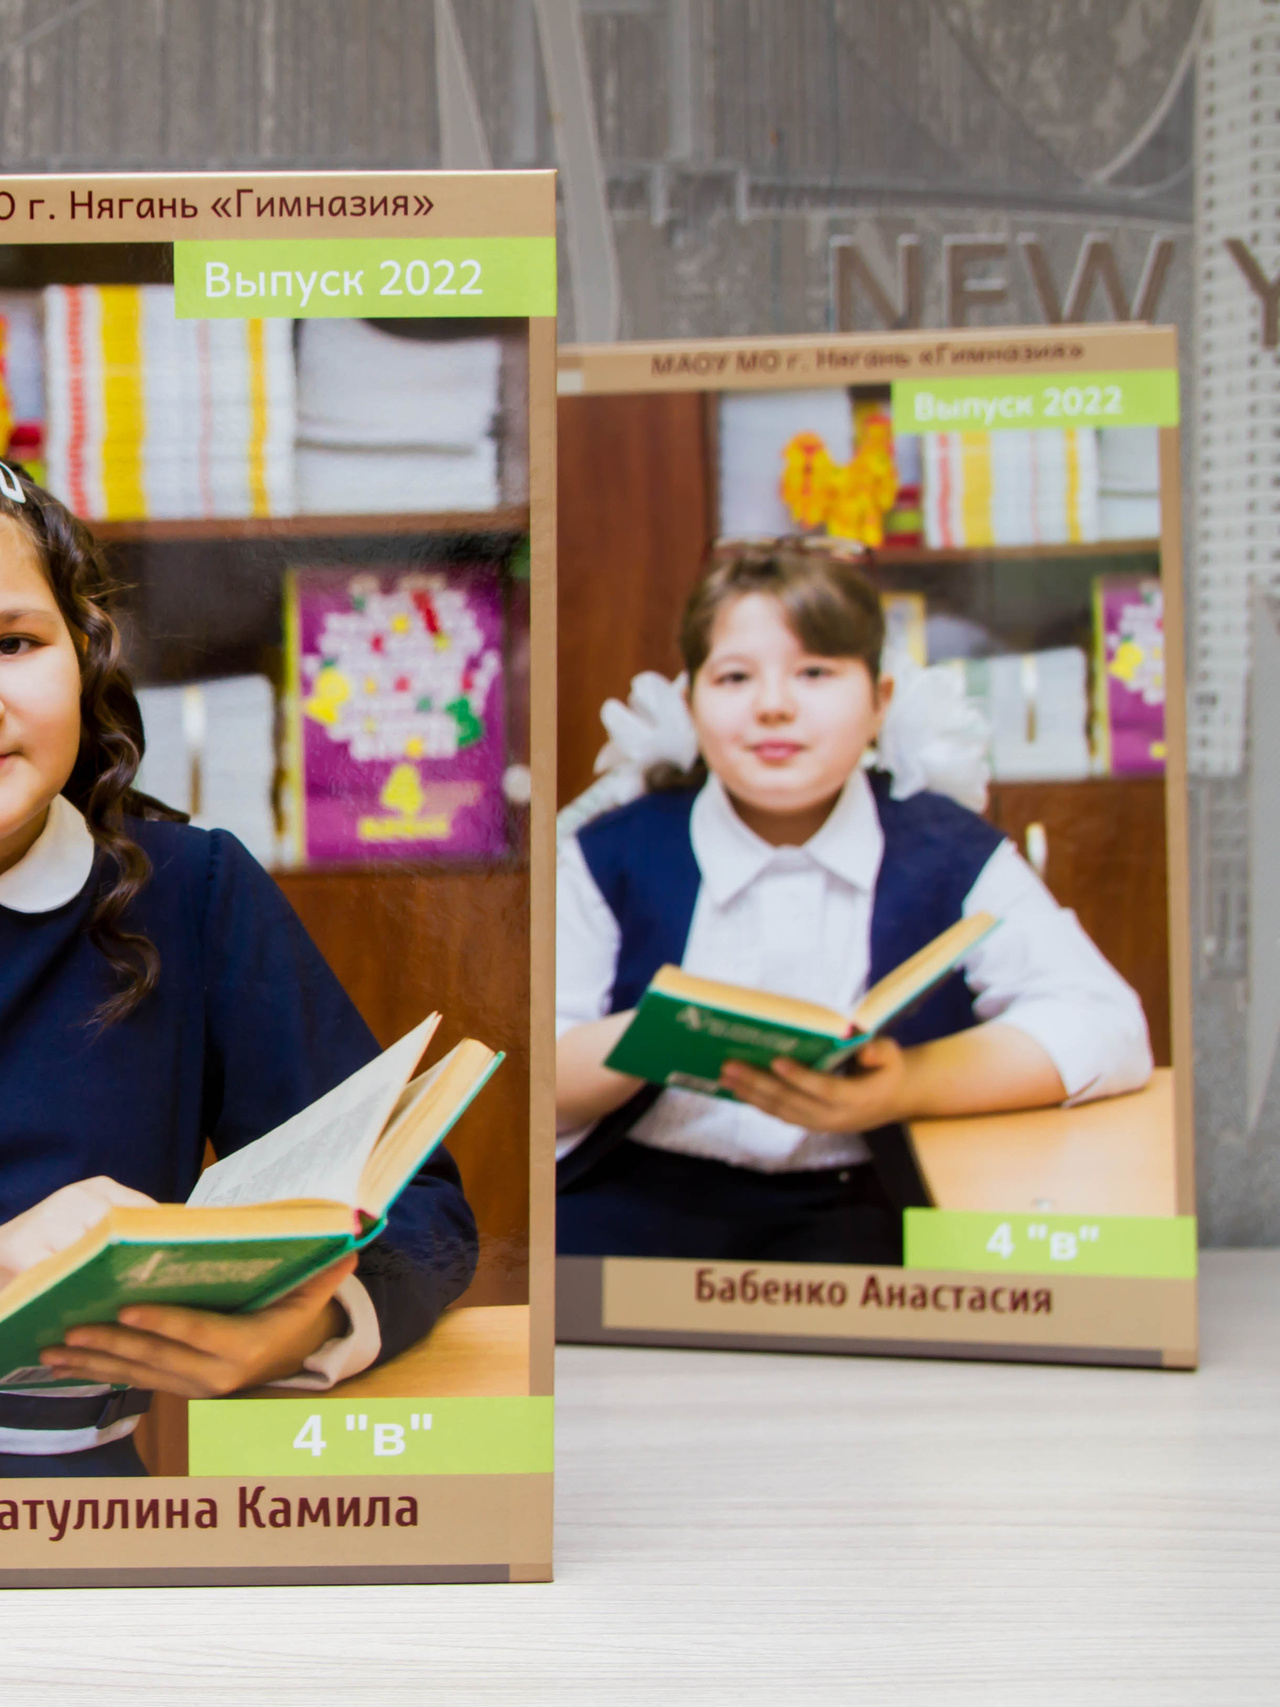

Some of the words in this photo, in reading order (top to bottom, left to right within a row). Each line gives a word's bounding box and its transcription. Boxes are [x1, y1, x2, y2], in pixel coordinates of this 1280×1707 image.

[28, 198, 57, 220] г.
[69, 189, 199, 220] Нягань
[210, 187, 435, 218] «Гимназия»
[204, 260, 365, 308] Выпуск
[378, 258, 484, 297] 2022
[651, 351, 729, 378] МАОУ
[735, 349, 782, 375] МО
[913, 391, 1035, 427] Выпуск
[1043, 385, 1123, 417] 2022
[985, 1222, 1016, 1260] 4
[694, 1267, 848, 1307] Бабенко
[859, 1273, 1053, 1315] Анастасия
[292, 1414, 327, 1458] 4
[236, 1485, 420, 1529] Камила
